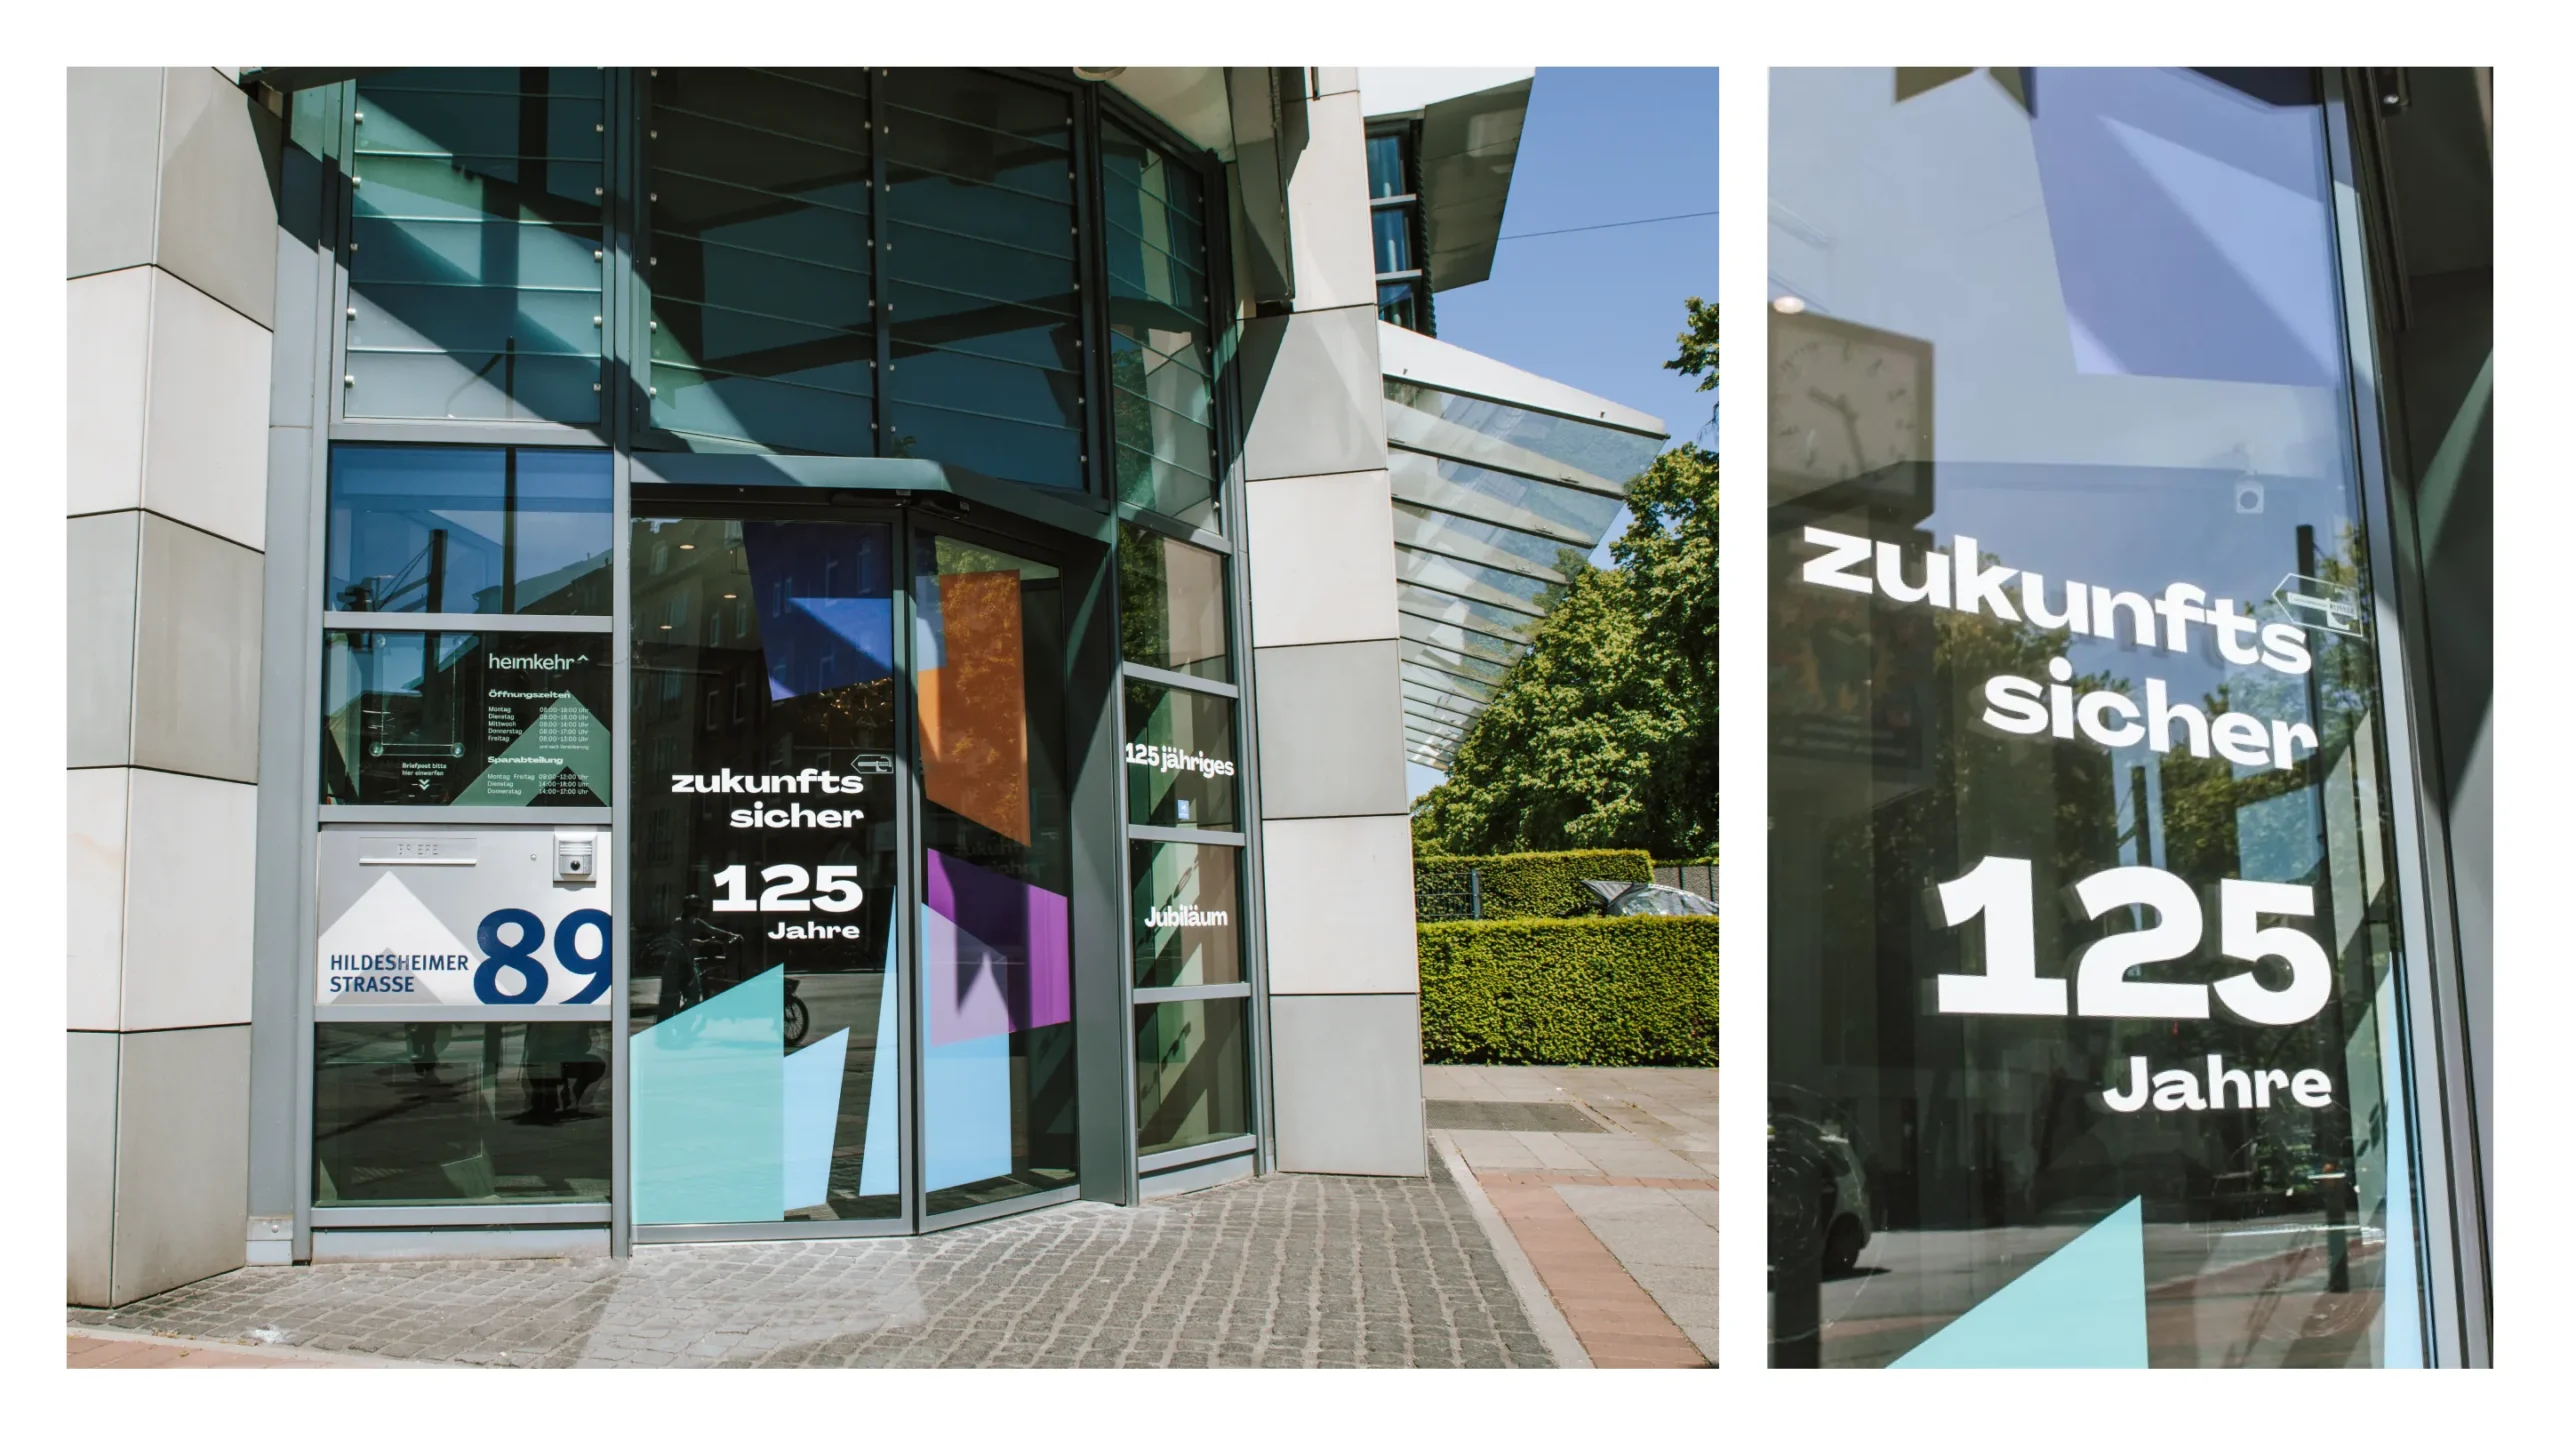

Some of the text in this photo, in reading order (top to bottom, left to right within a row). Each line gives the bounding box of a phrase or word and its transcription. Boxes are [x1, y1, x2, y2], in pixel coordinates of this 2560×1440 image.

[1803, 526, 2312, 674] zukunfts
[489, 653, 575, 670] heimkehr
[488, 689, 571, 699] Öffnungszeiten
[488, 713, 515, 721] Dienstag
[1983, 657, 2318, 770] sicher
[488, 735, 510, 743] Freitag
[402, 762, 431, 770] Briefpost
[487, 756, 564, 766] Sparabteilung
[1125, 743, 1235, 778] 125 jähriges
[487, 780, 514, 788] Dienstag
[672, 768, 864, 793] zukunfts
[730, 801, 865, 828] sicher
[398, 843, 439, 855] BREFE
[712, 863, 864, 913] 125
[1144, 903, 1228, 927] Jubiläum
[768, 921, 860, 939] Jahre
[1937, 855, 2332, 1026] 125
[330, 955, 469, 971] HILDESHEIMER
[474, 908, 612, 1005] 89
[330, 976, 415, 992] STRASSE
[2102, 1054, 2332, 1113] Jahre
